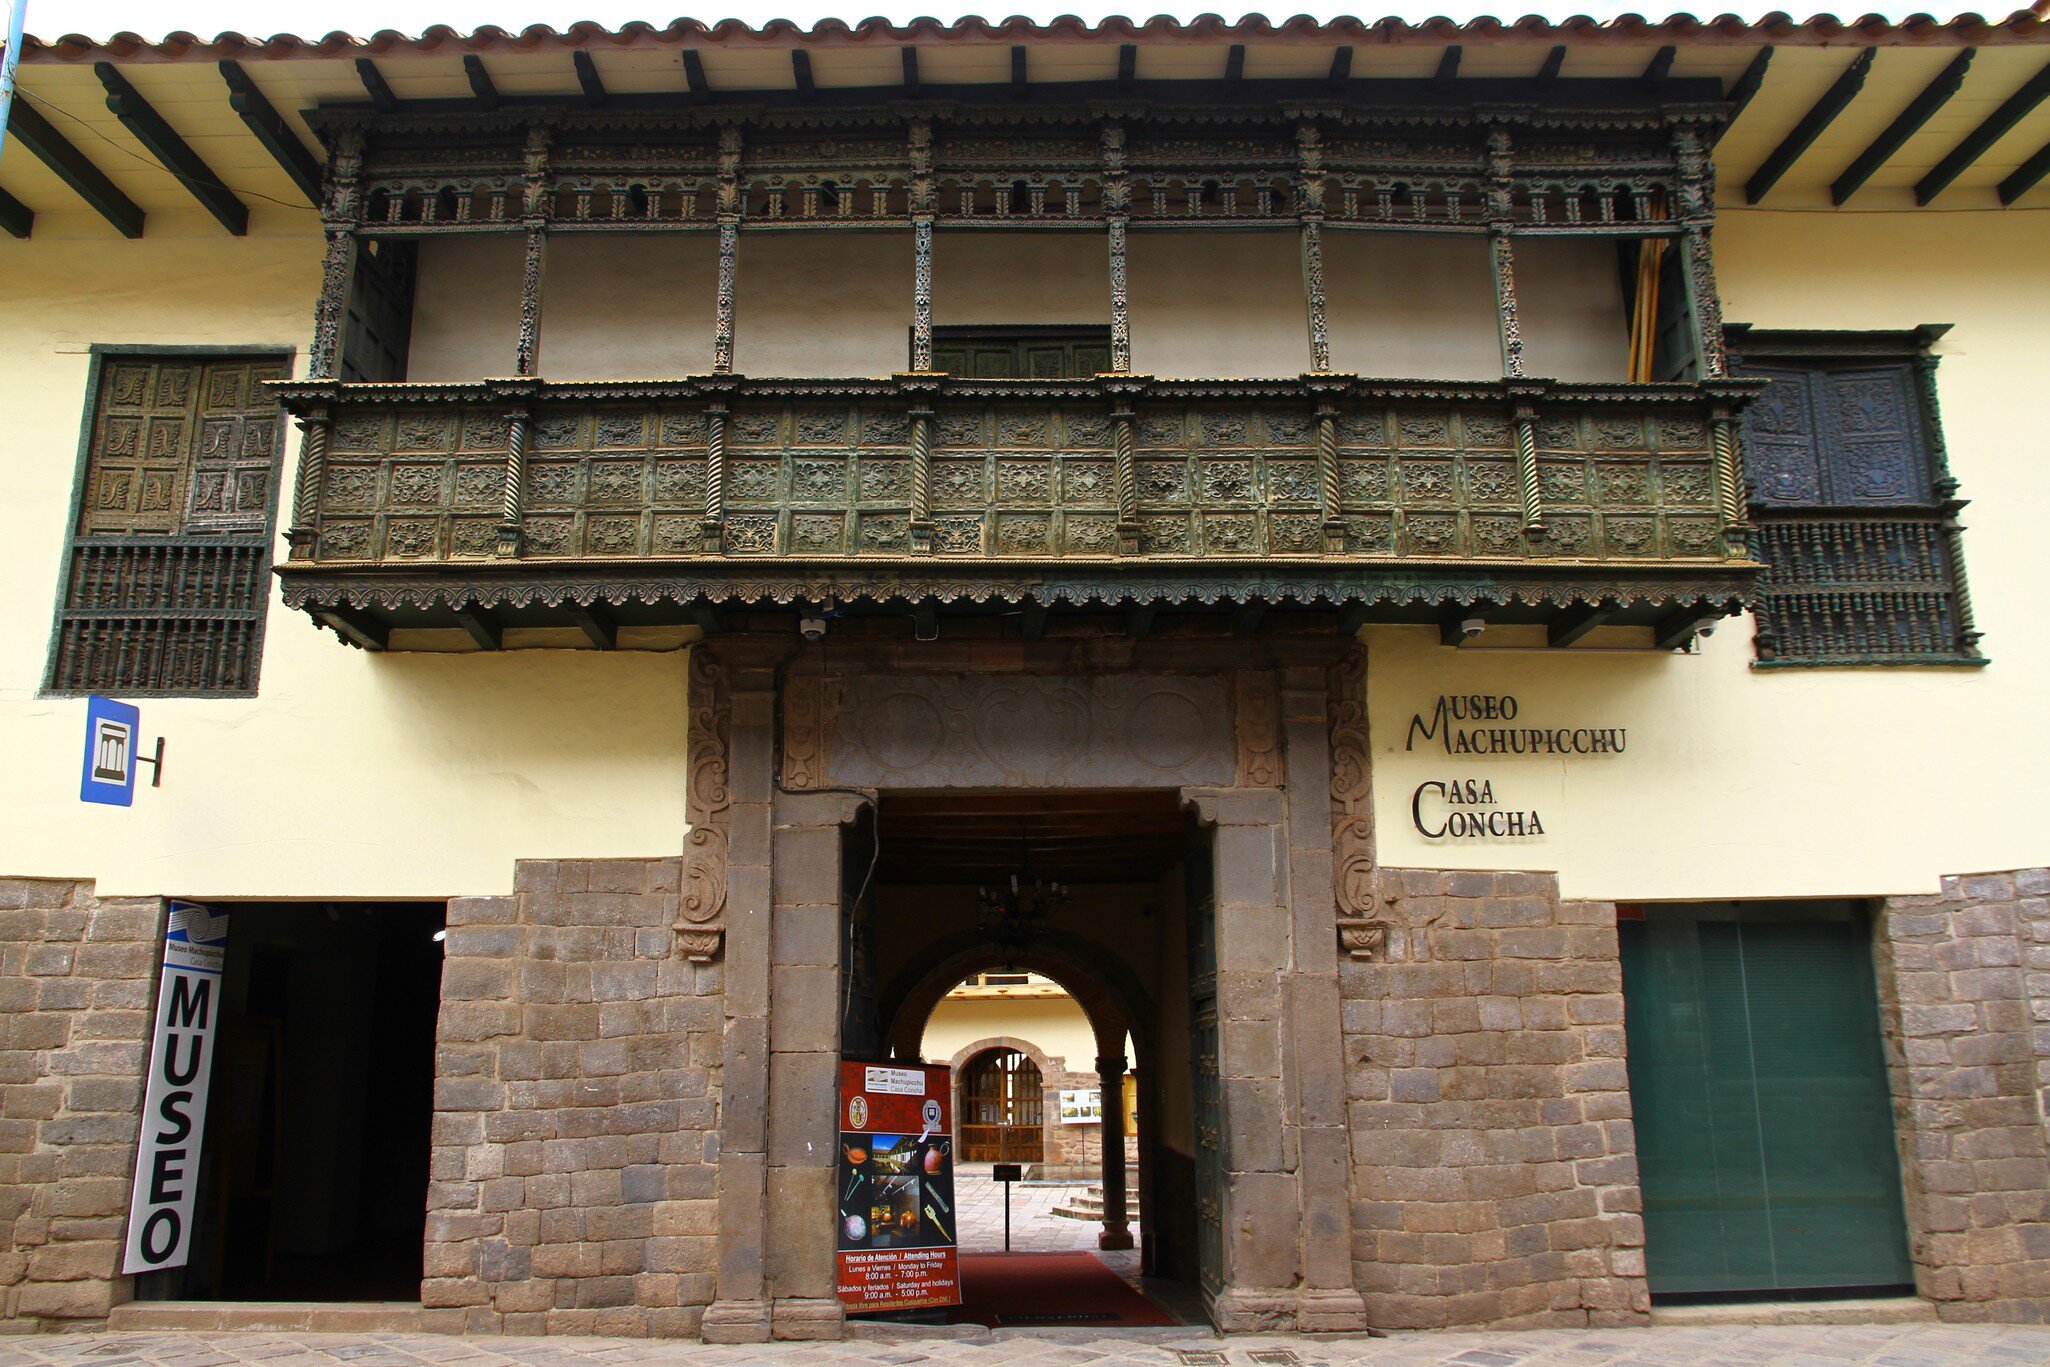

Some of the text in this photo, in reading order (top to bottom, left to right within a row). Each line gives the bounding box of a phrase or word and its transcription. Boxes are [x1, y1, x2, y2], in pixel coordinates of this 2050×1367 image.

[1406, 695, 1518, 754] MUSEO
[1412, 779, 1497, 838] CASA
[169, 943, 188, 953] Museo
[890, 1078, 923, 1086] Machupicchu
[140, 975, 211, 1264] MUSEO
[875, 1252, 897, 1261] Atención
[904, 1252, 929, 1260] Attending
[930, 1251, 946, 1259] Hours
[926, 1261, 943, 1269] Friday
[896, 1281, 920, 1289] Saturday
